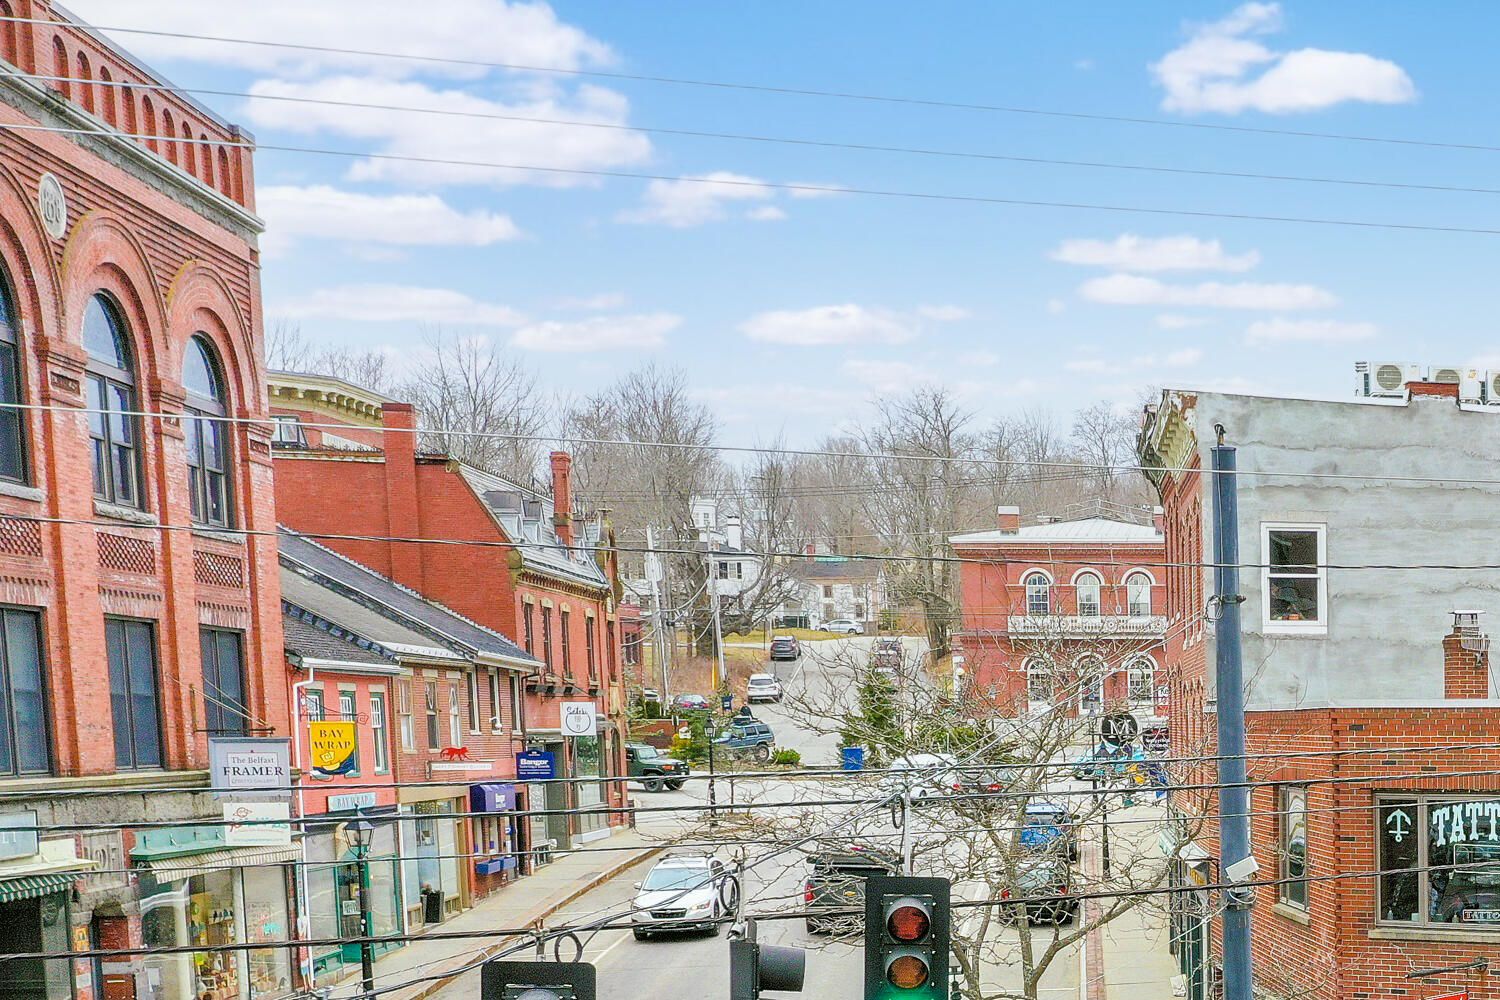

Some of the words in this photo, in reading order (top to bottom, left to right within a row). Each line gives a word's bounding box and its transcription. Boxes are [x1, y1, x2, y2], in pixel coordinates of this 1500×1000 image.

[320, 729, 344, 738] BAY
[313, 741, 351, 749] WRAP
[520, 758, 549, 767] Bangor
[223, 766, 284, 776] FRAMER
[337, 797, 349, 806] BAY
